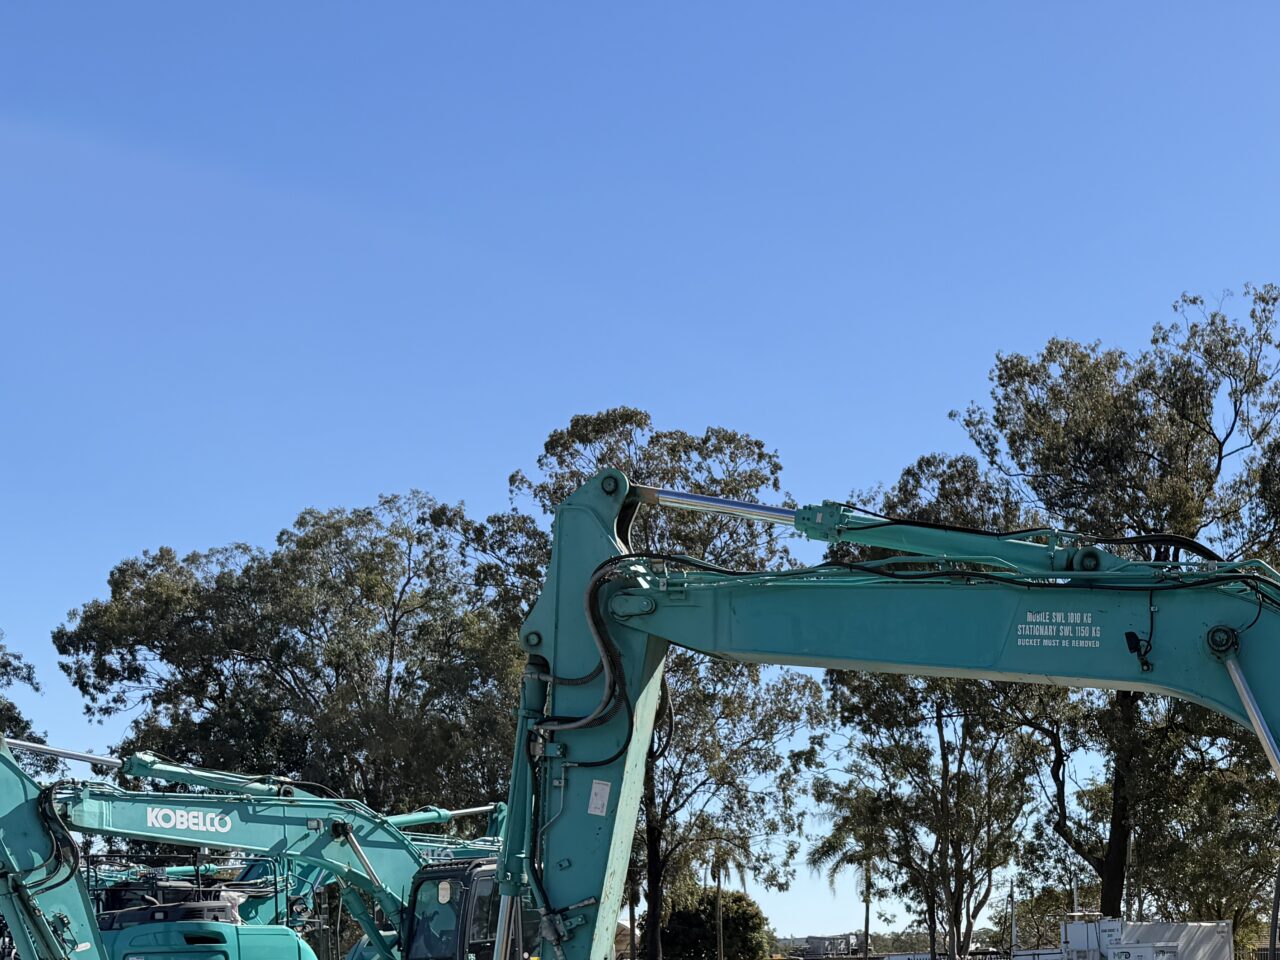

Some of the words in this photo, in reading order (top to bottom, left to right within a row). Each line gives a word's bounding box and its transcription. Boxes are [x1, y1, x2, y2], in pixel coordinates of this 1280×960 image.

[1027, 612, 1049, 623] MOBILE
[1052, 612, 1065, 623] SWL
[1083, 613, 1092, 623] KG
[1017, 624, 1057, 636] STATIONARY
[1060, 625, 1073, 636] SWL
[1075, 626, 1089, 637] 1150
[1092, 627, 1101, 637] KG
[1017, 638, 1041, 646] BUCKET
[1042, 639, 1059, 647] MUST
[146, 806, 232, 833] KOBELCO
